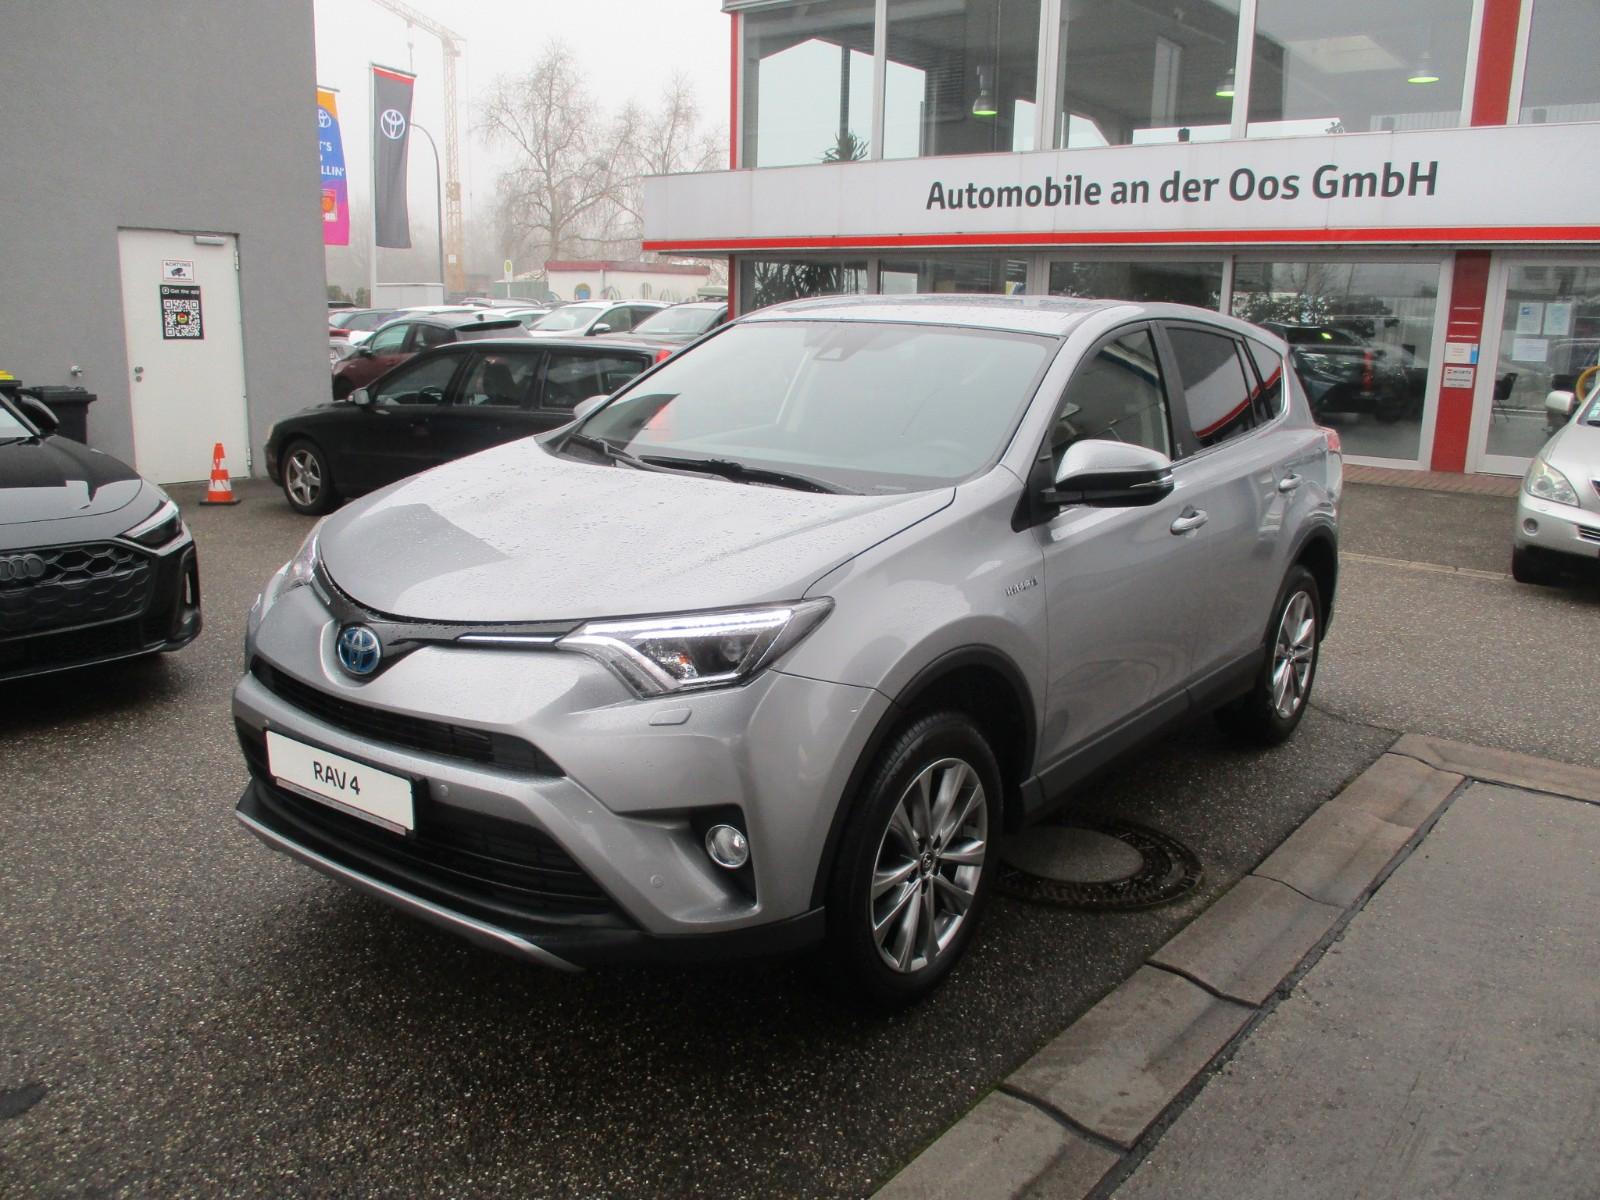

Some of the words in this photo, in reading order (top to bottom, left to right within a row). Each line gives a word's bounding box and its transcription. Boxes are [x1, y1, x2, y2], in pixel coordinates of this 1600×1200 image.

[320, 141, 332, 152] T'S
[321, 165, 344, 177] LLIN'
[927, 175, 1101, 210] Automobile
[1111, 181, 1149, 205] an
[1160, 170, 1219, 204] der
[1230, 167, 1299, 202] Oos
[1313, 160, 1439, 199] GmbH
